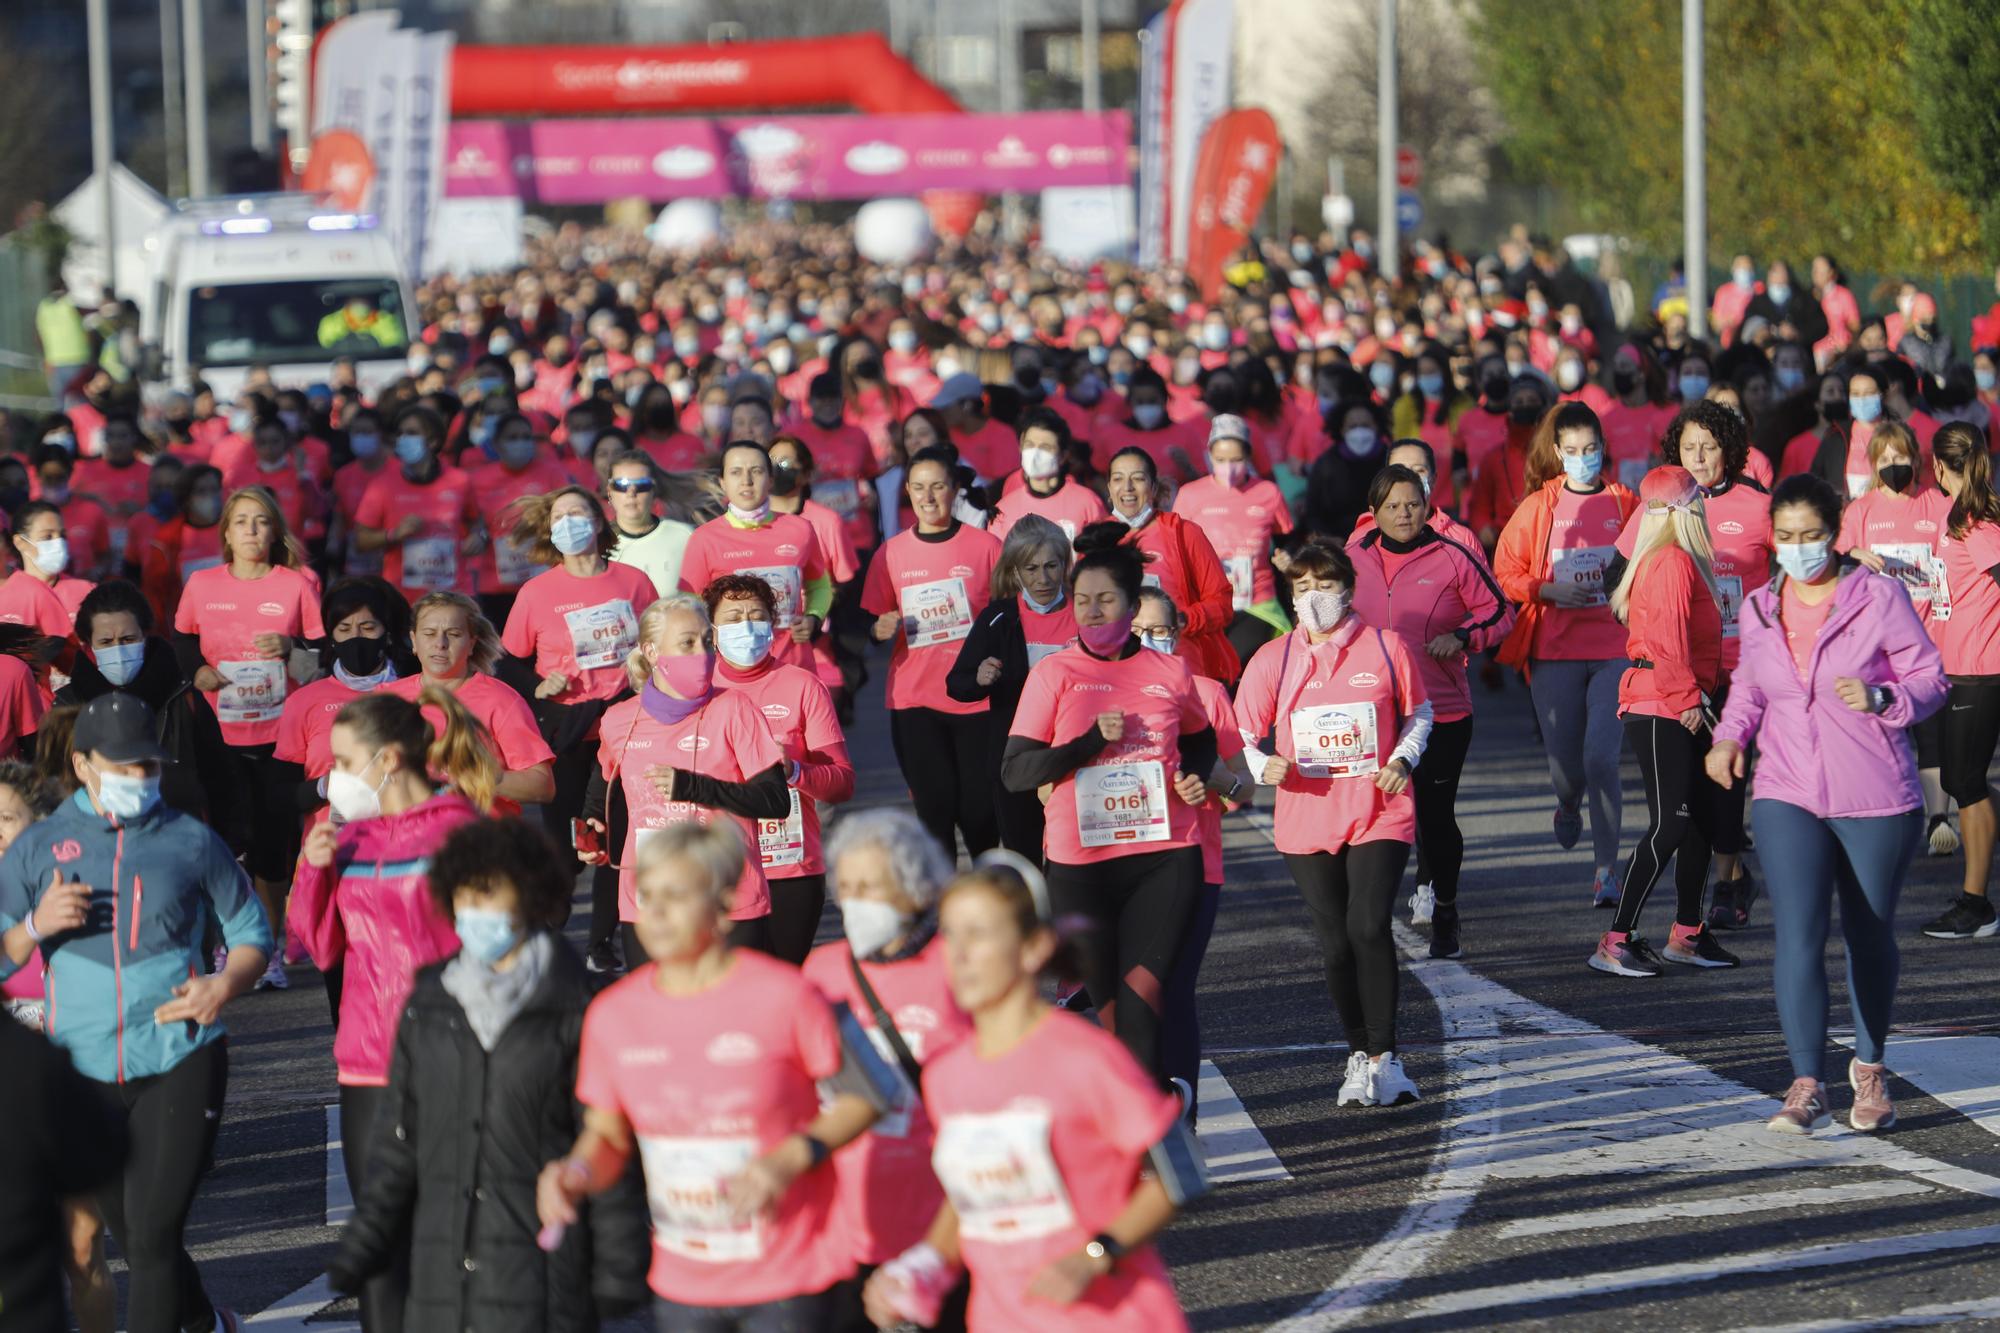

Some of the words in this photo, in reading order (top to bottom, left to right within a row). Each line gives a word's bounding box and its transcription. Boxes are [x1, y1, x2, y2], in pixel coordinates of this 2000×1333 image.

[901, 569, 928, 578] OYSHO
[554, 602, 584, 613] OYSHO
[920, 604, 949, 620] 016
[592, 625, 620, 641] 016
[237, 684, 265, 697] 016
[1074, 683, 1112, 692] OYSHO
[1139, 731, 1164, 742] POR
[1319, 733, 1353, 748] 016
[1123, 743, 1163, 756] TODAS
[1104, 795, 1140, 811] 016
